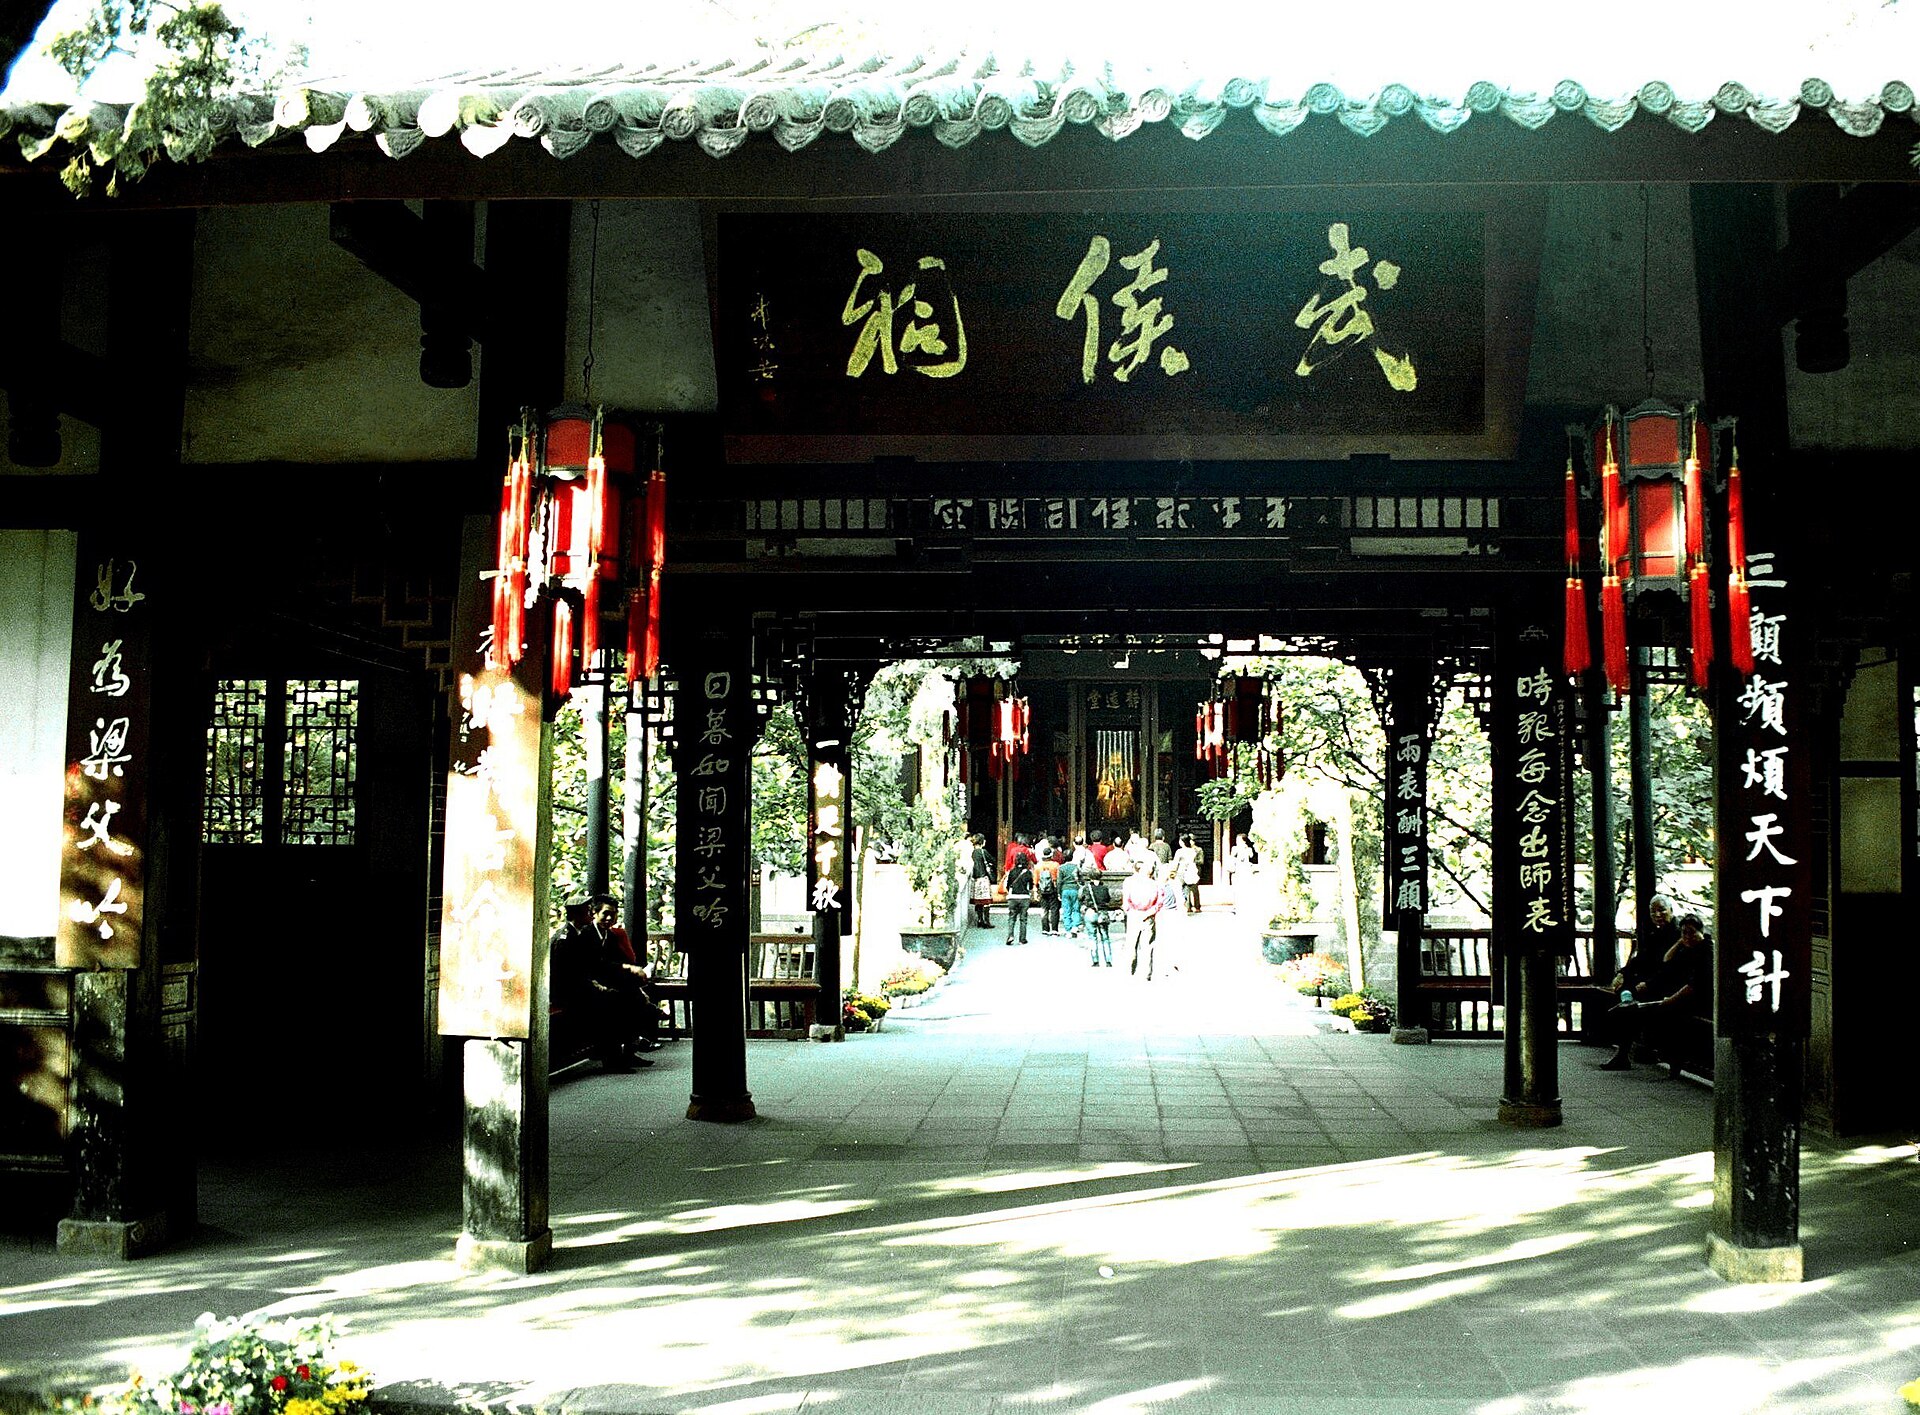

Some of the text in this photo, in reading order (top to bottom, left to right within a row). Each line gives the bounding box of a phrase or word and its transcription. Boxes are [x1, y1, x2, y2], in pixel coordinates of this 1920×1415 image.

[842, 222, 1417, 392] 武侯祠
[690, 670, 733, 930] 日暮如聞梁父吟
